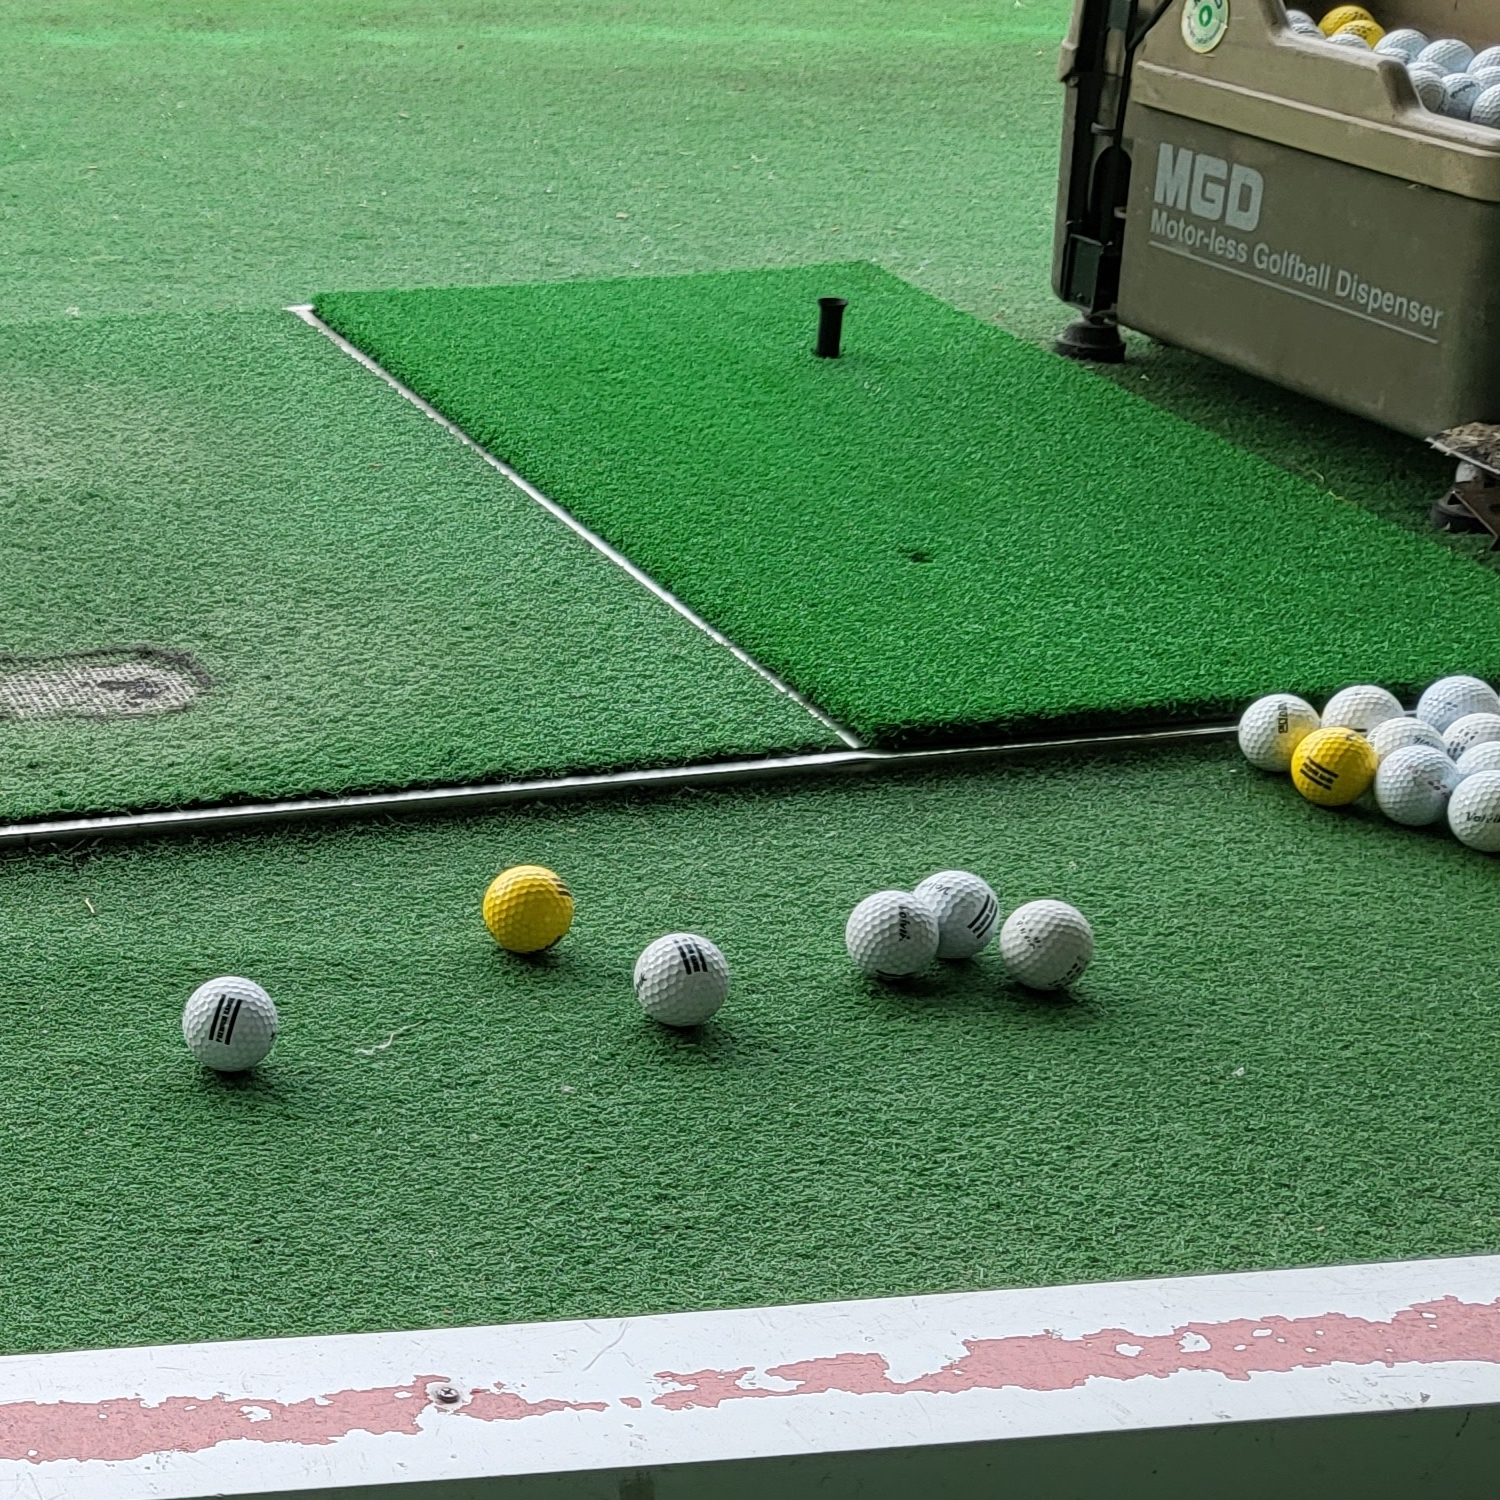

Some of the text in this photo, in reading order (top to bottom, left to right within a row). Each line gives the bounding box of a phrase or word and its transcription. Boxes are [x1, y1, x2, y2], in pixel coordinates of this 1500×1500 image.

[1153, 142, 1264, 232] MGD
[1150, 208, 1444, 329] Motor-less Golfball Dispenser
